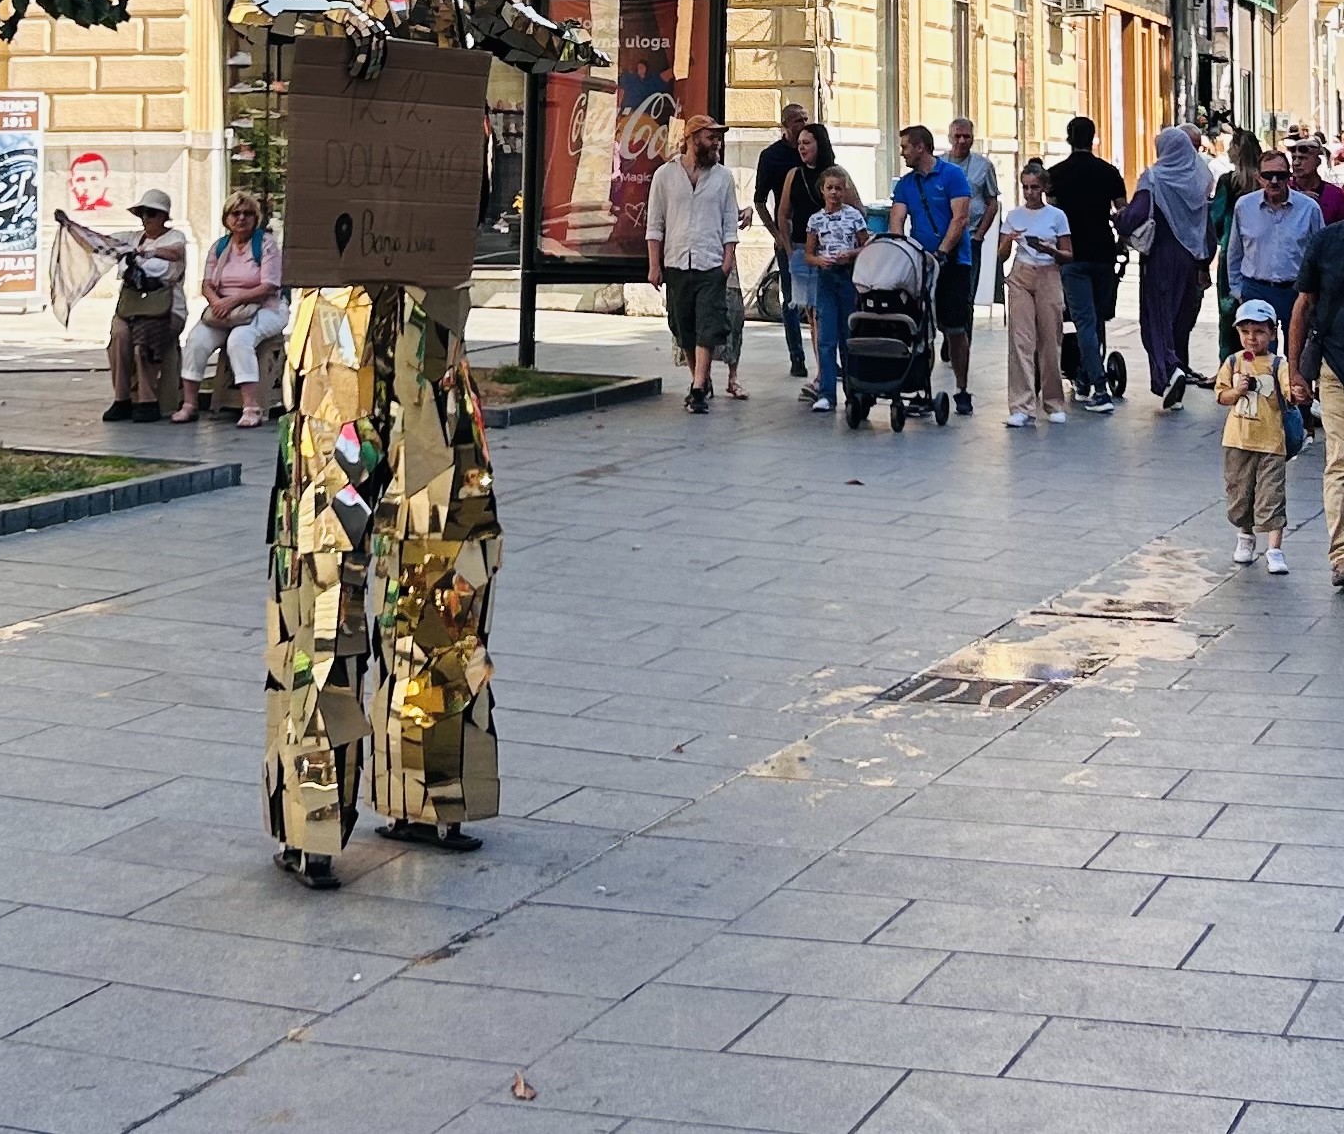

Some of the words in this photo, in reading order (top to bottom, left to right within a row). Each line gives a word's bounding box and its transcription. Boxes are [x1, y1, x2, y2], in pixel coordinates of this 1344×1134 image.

[625, 34, 671, 50] uloga
[1, 116, 33, 128] 1911
[325, 139, 467, 194] DOLAZIMO
[622, 172, 653, 184] Magic
